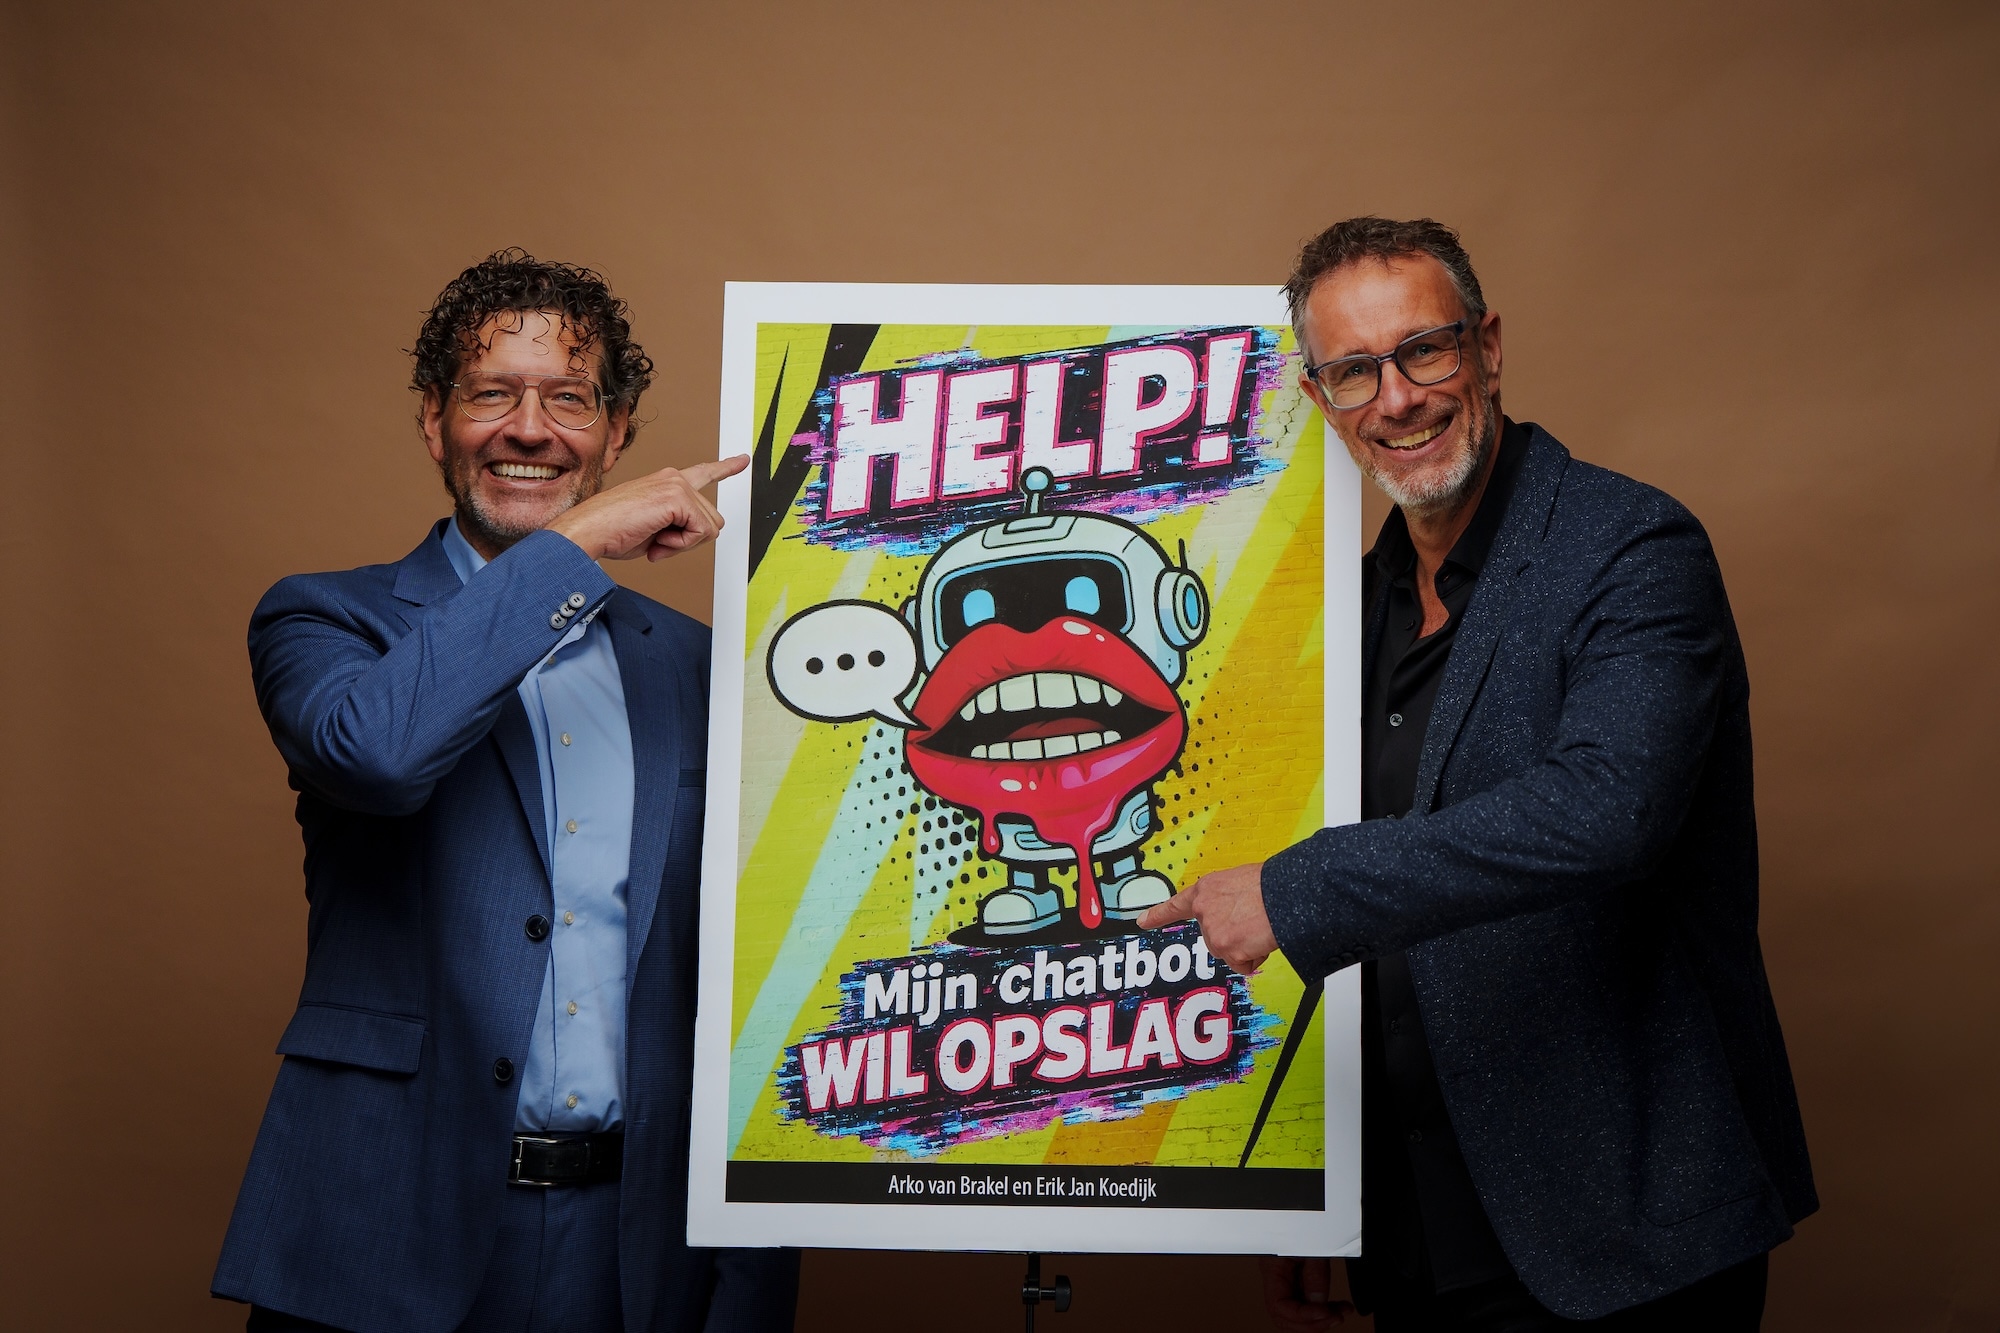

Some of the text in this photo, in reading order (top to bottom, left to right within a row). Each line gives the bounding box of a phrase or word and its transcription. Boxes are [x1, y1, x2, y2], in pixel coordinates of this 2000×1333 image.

[827, 331, 1252, 519] HELP!
[863, 936, 1216, 1025] Mijn chatbot
[801, 987, 1233, 1112] WIL OPSLAG
[888, 1175, 1157, 1202] Arko van Brakel en Erik Jan Koedijk
